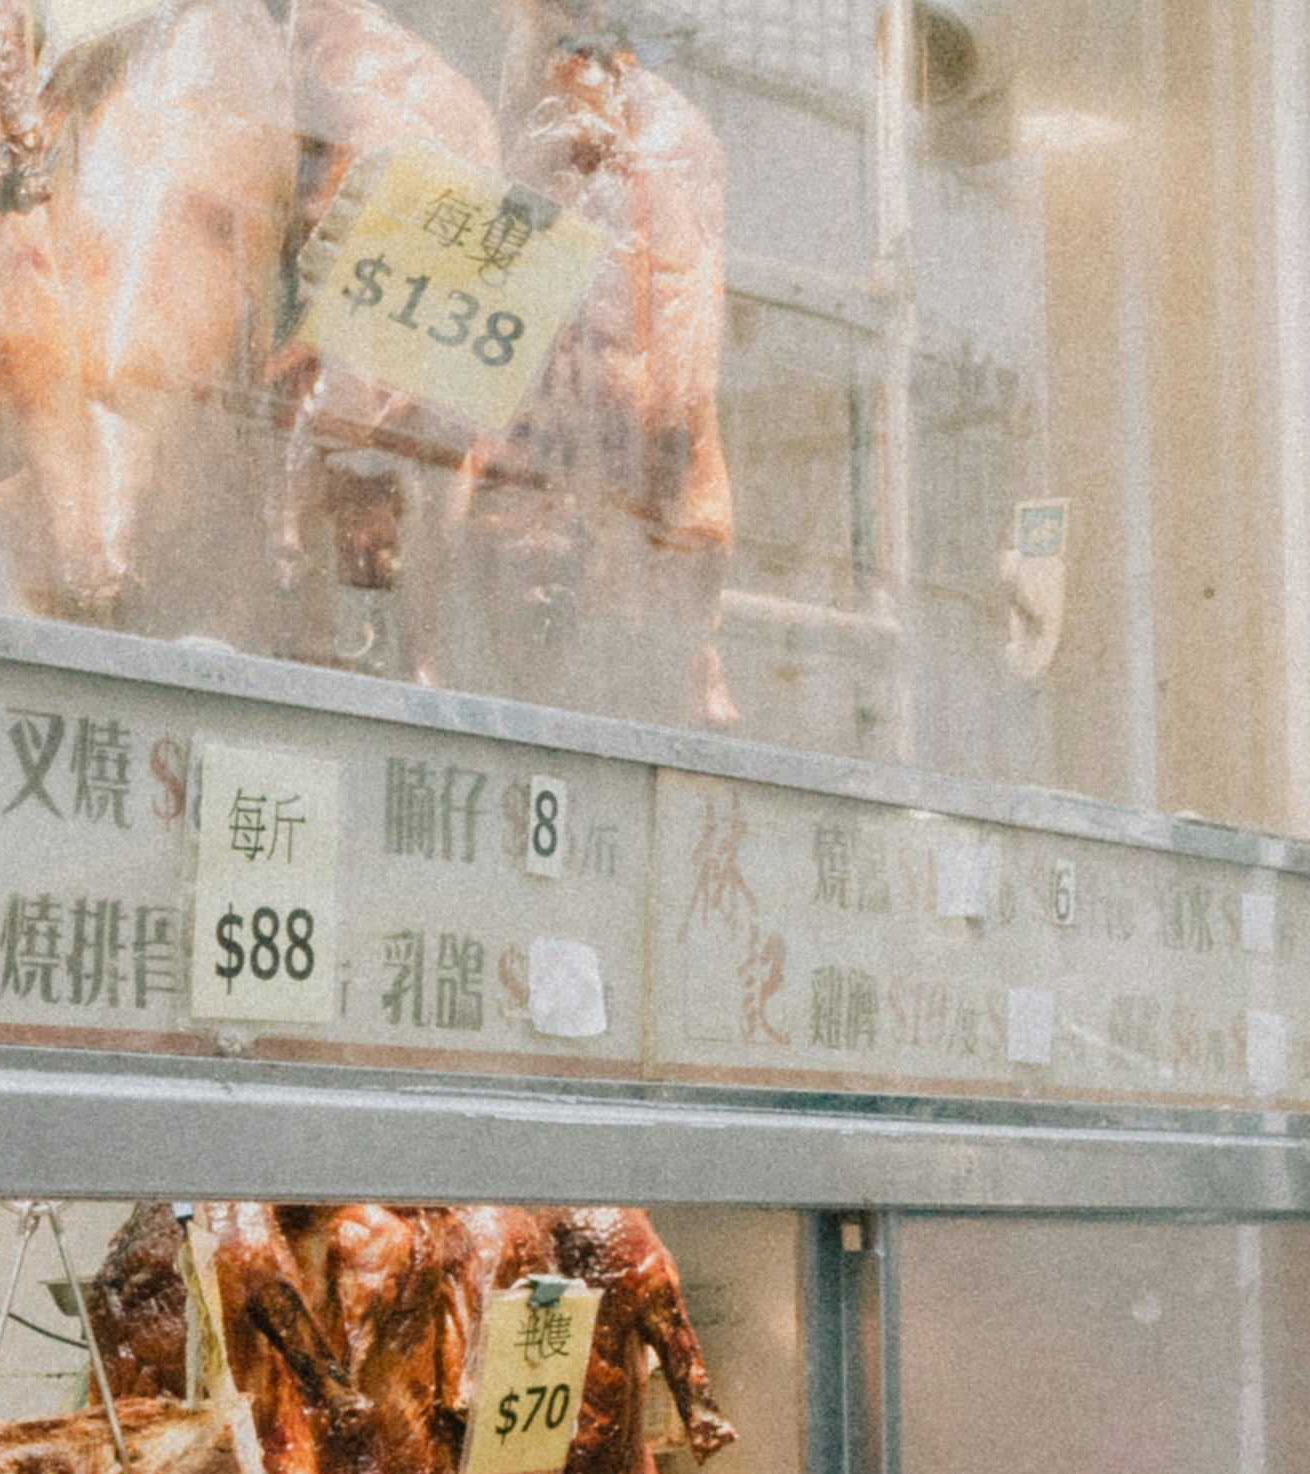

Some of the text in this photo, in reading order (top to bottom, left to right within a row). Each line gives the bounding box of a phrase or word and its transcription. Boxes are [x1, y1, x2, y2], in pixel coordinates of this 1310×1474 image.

[342, 253, 525, 368] $138
[2, 706, 134, 831] 叉燒
[227, 787, 307, 864] 每斤
[214, 902, 315, 996] $88
[495, 1383, 571, 1445] $70
